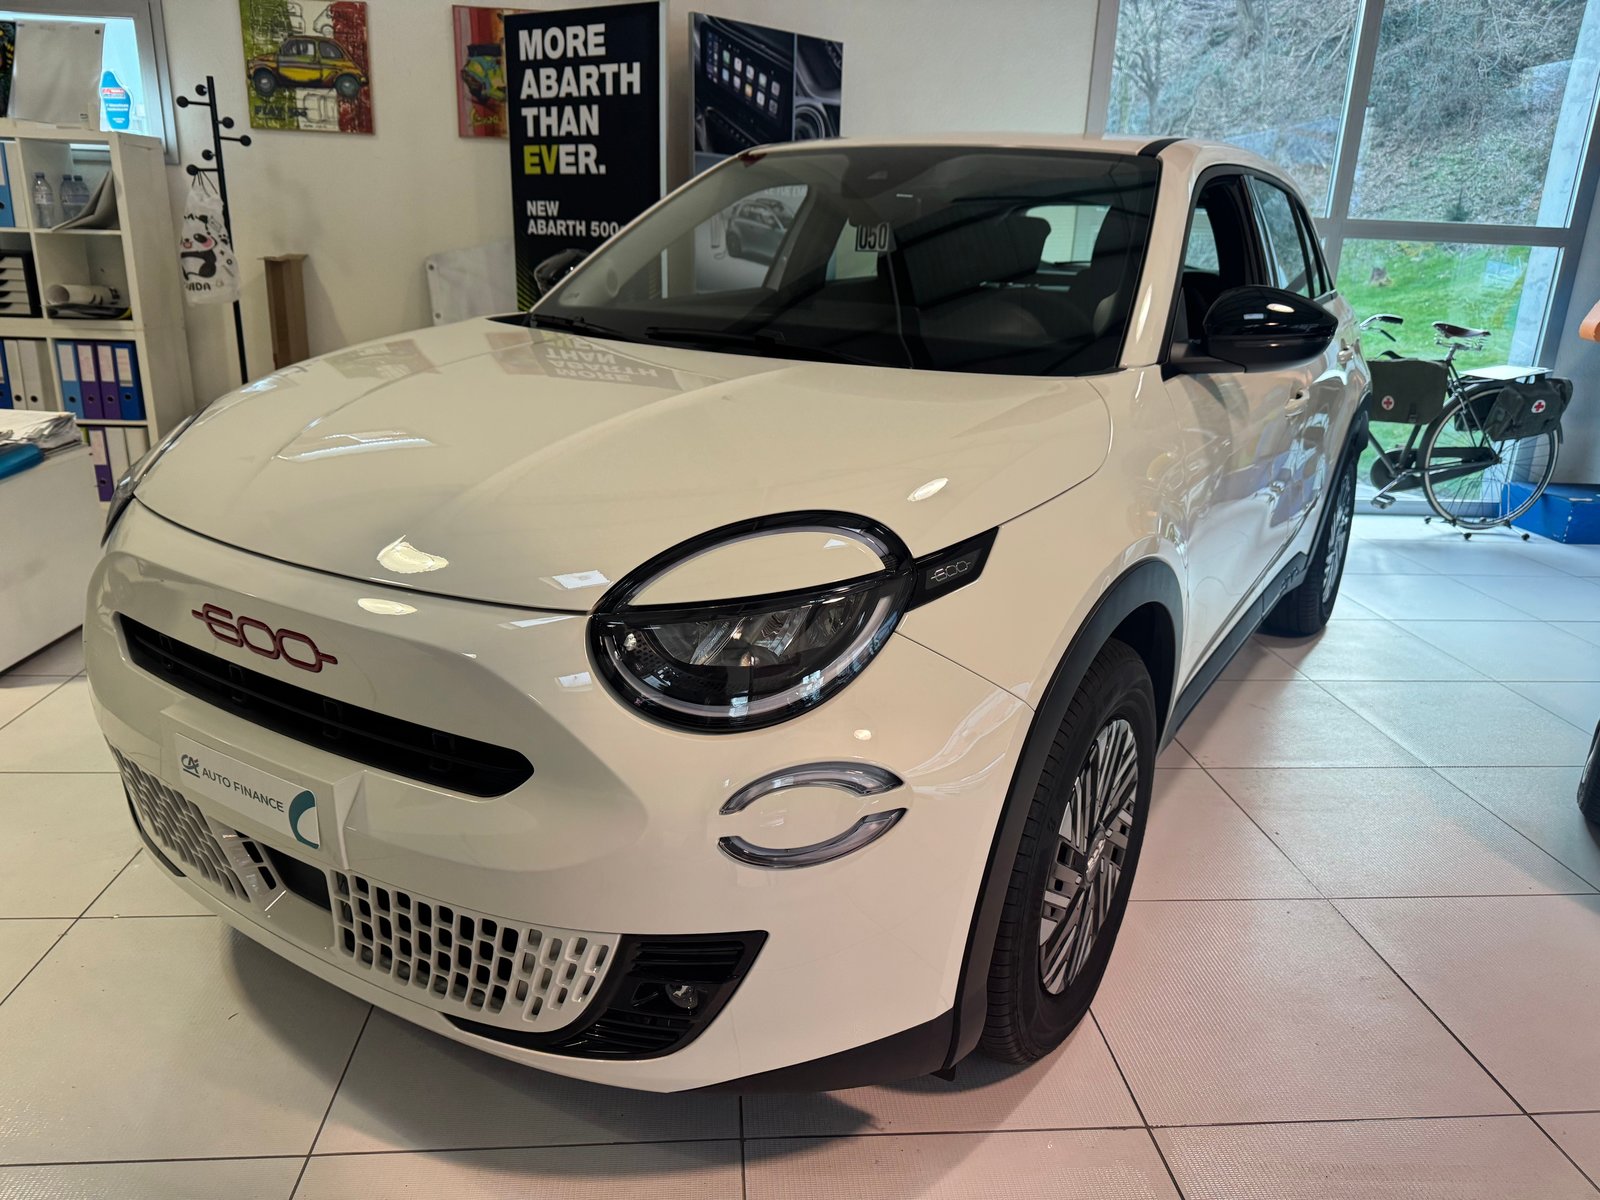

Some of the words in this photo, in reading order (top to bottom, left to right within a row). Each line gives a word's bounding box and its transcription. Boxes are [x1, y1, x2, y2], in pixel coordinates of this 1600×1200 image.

[518, 23, 606, 61] MORE
[520, 62, 641, 100] ABARTH
[521, 104, 600, 138] THAN
[523, 143, 606, 175] EVER.
[526, 200, 560, 217] NEW
[527, 218, 587, 237] ABARTH
[590, 220, 625, 238] 500
[202, 767, 231, 788] AUTO
[233, 781, 285, 813] FINANCE
